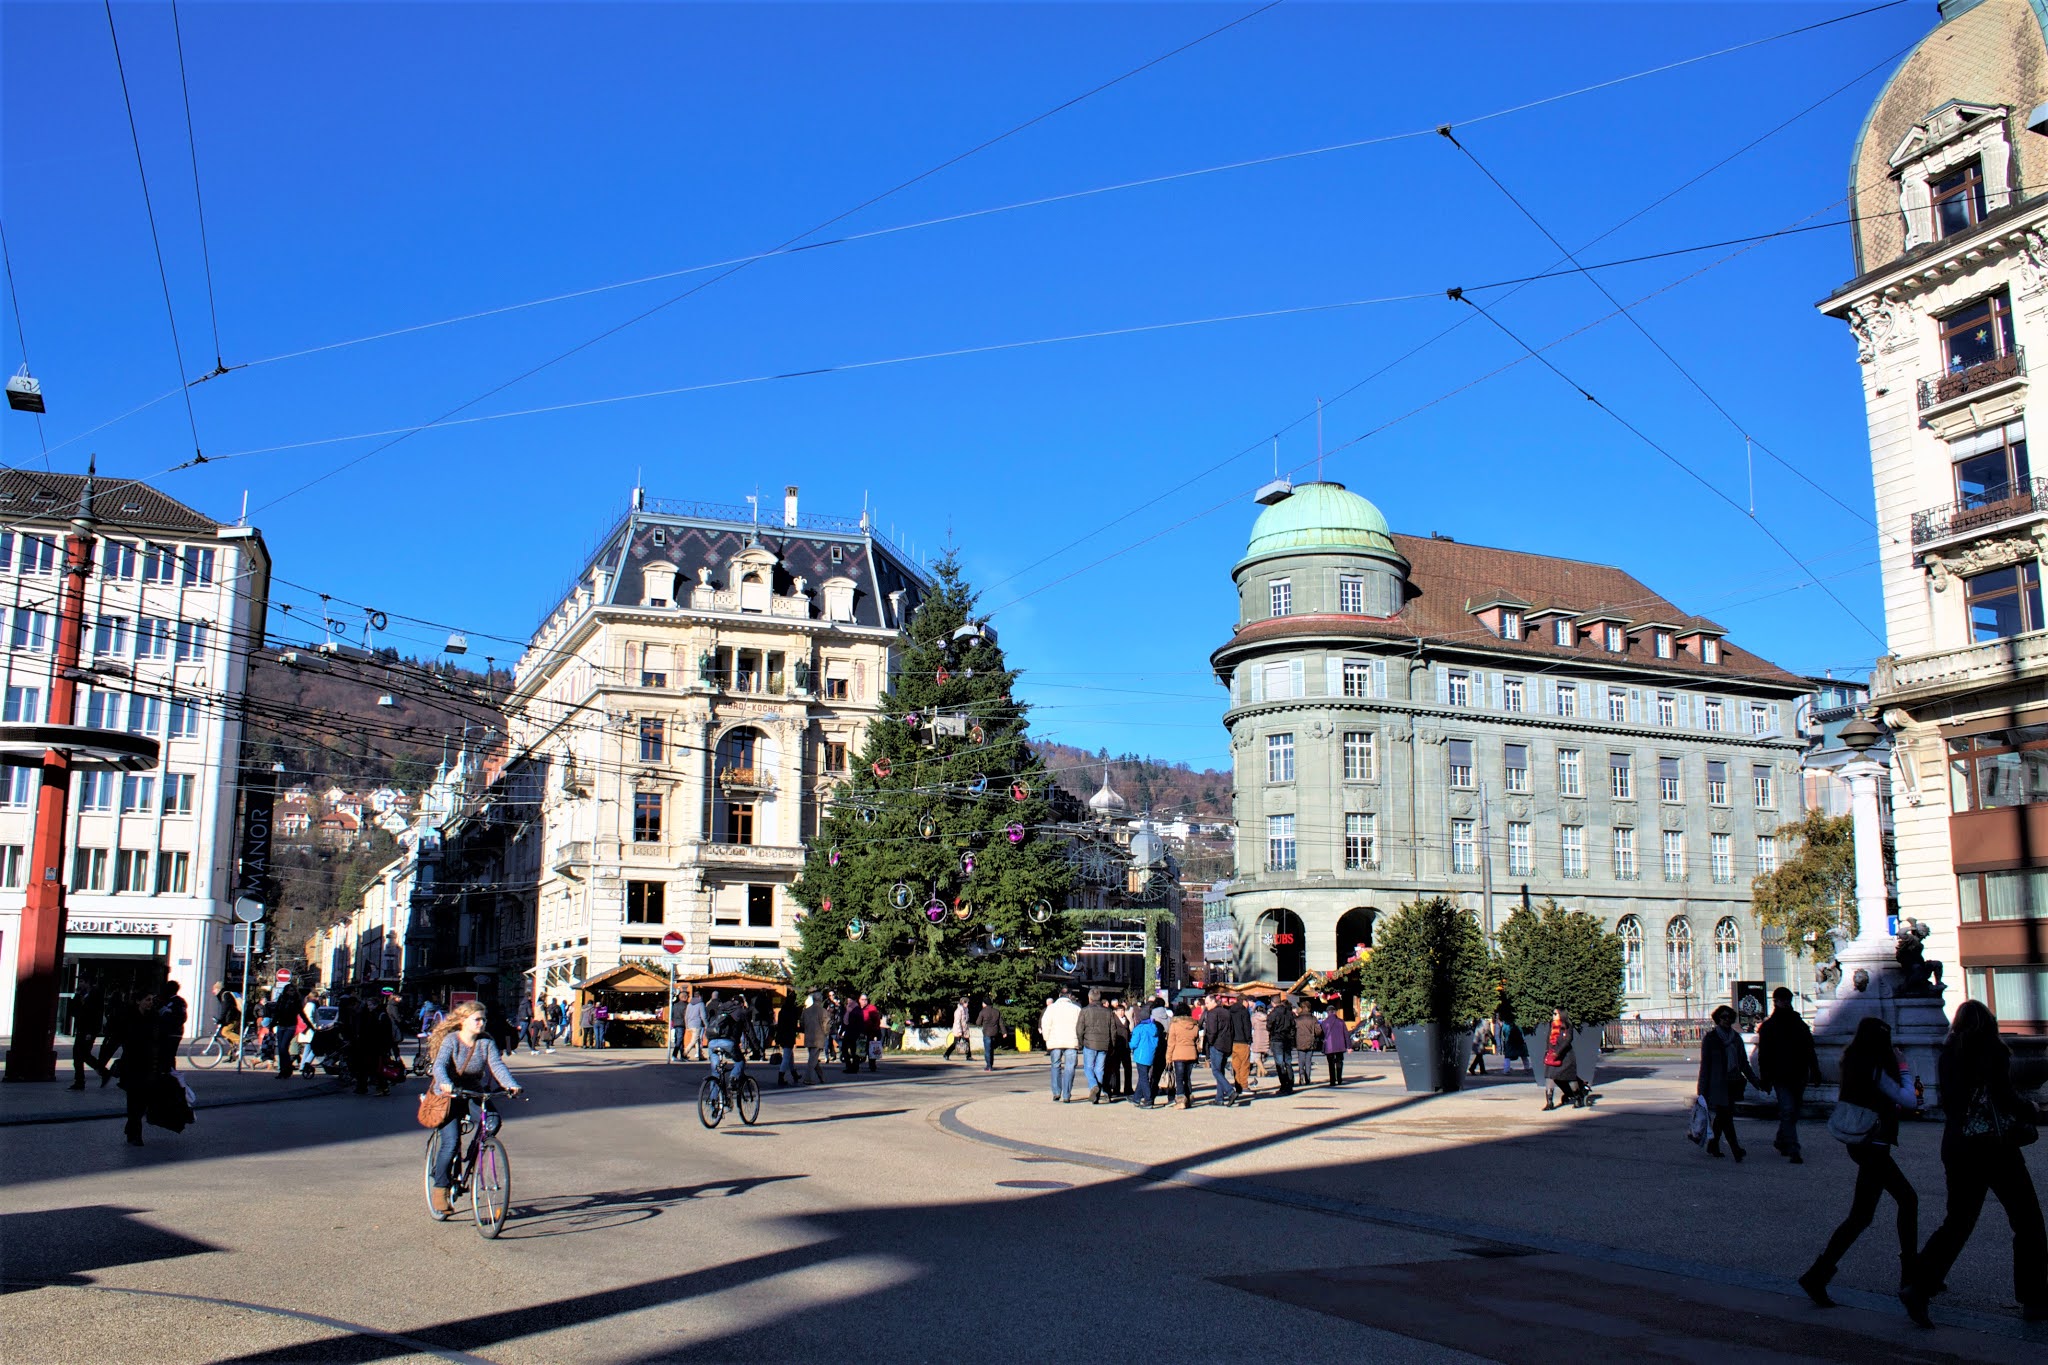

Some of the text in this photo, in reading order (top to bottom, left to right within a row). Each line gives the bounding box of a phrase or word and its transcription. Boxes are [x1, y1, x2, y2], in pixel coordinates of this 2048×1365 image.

[247, 809, 268, 891] MANOR
[114, 920, 160, 933] SUISSE
[1273, 933, 1294, 944] UBS
